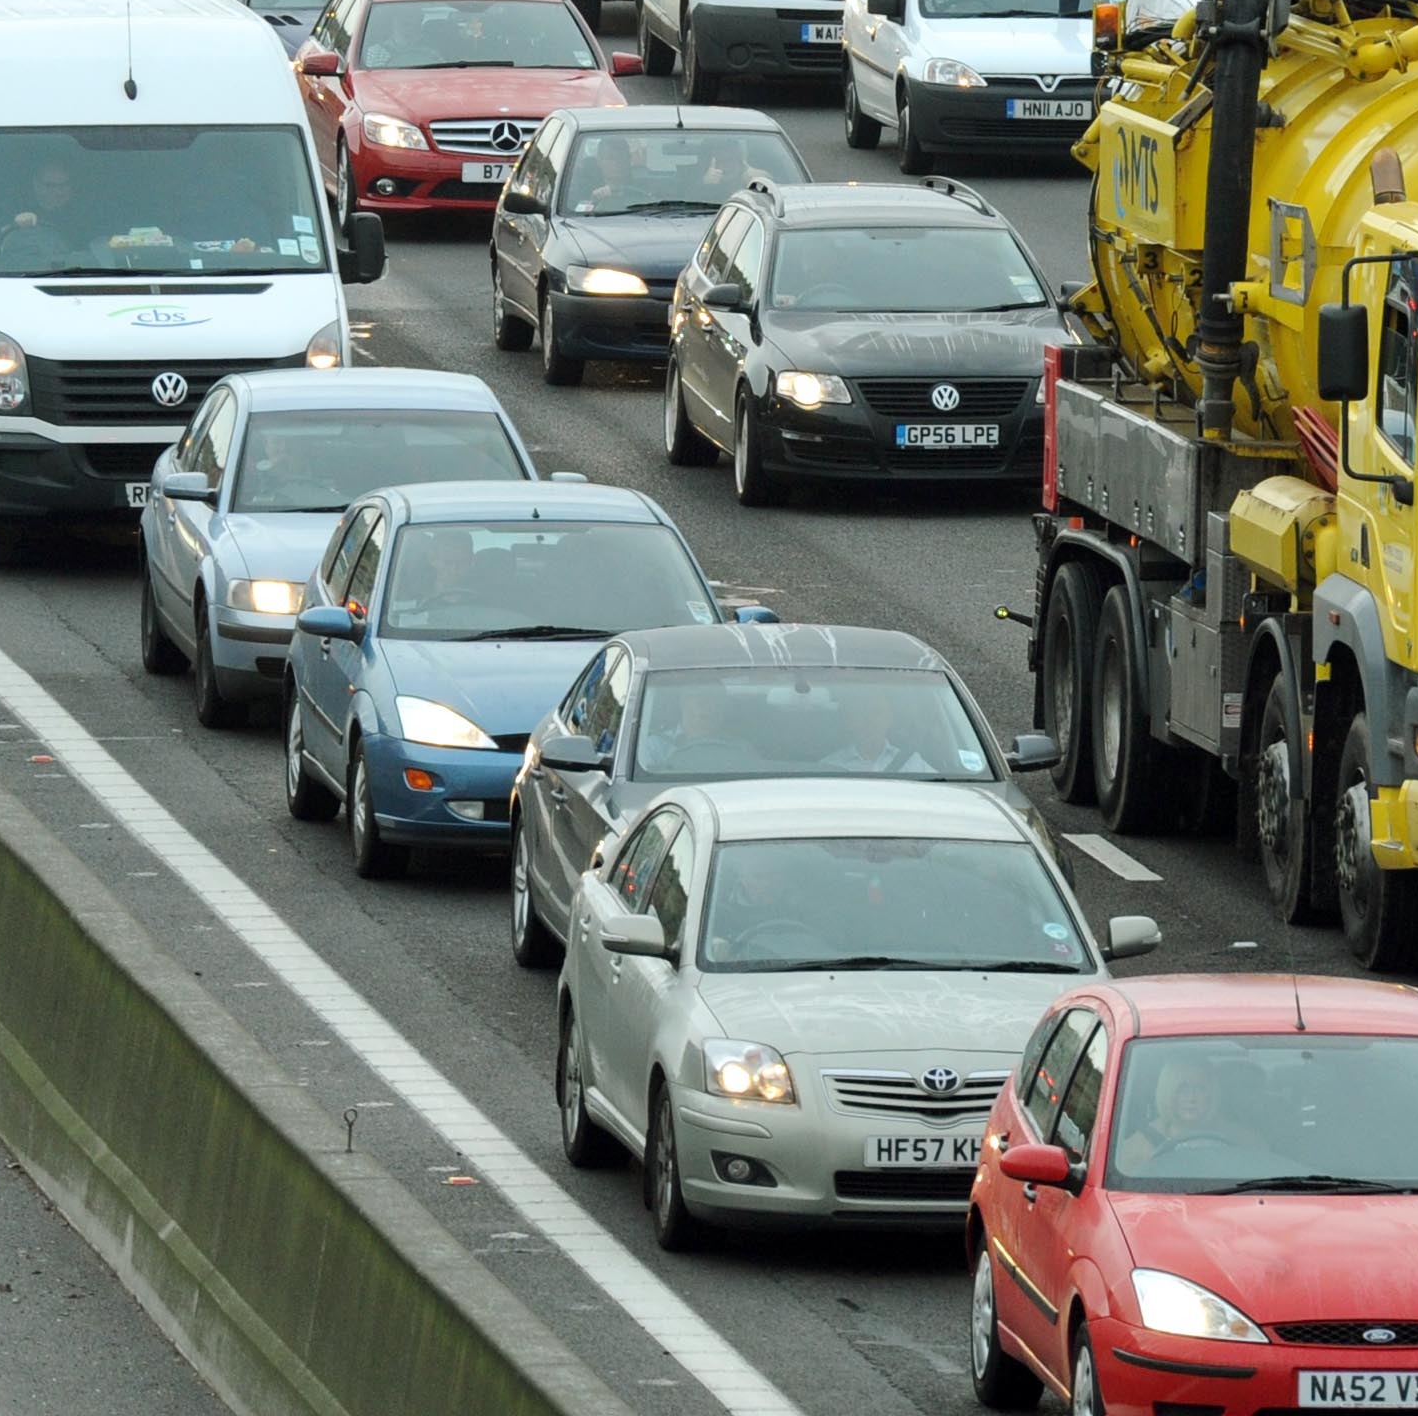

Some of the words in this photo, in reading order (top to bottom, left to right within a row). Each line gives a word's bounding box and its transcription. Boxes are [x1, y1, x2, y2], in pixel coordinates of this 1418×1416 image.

[1022, 103, 1050, 116] HN11
[1055, 103, 1084, 117] AJO
[483, 164, 503, 179] B7
[1131, 130, 1158, 214] MTS
[1145, 251, 1159, 269] 3
[137, 309, 186, 322] cbs
[907, 426, 956, 444] GP56
[961, 426, 997, 444] LPE
[877, 1138, 944, 1162] HF57
[953, 1138, 981, 1162] KH
[1311, 1375, 1385, 1402] NA52
